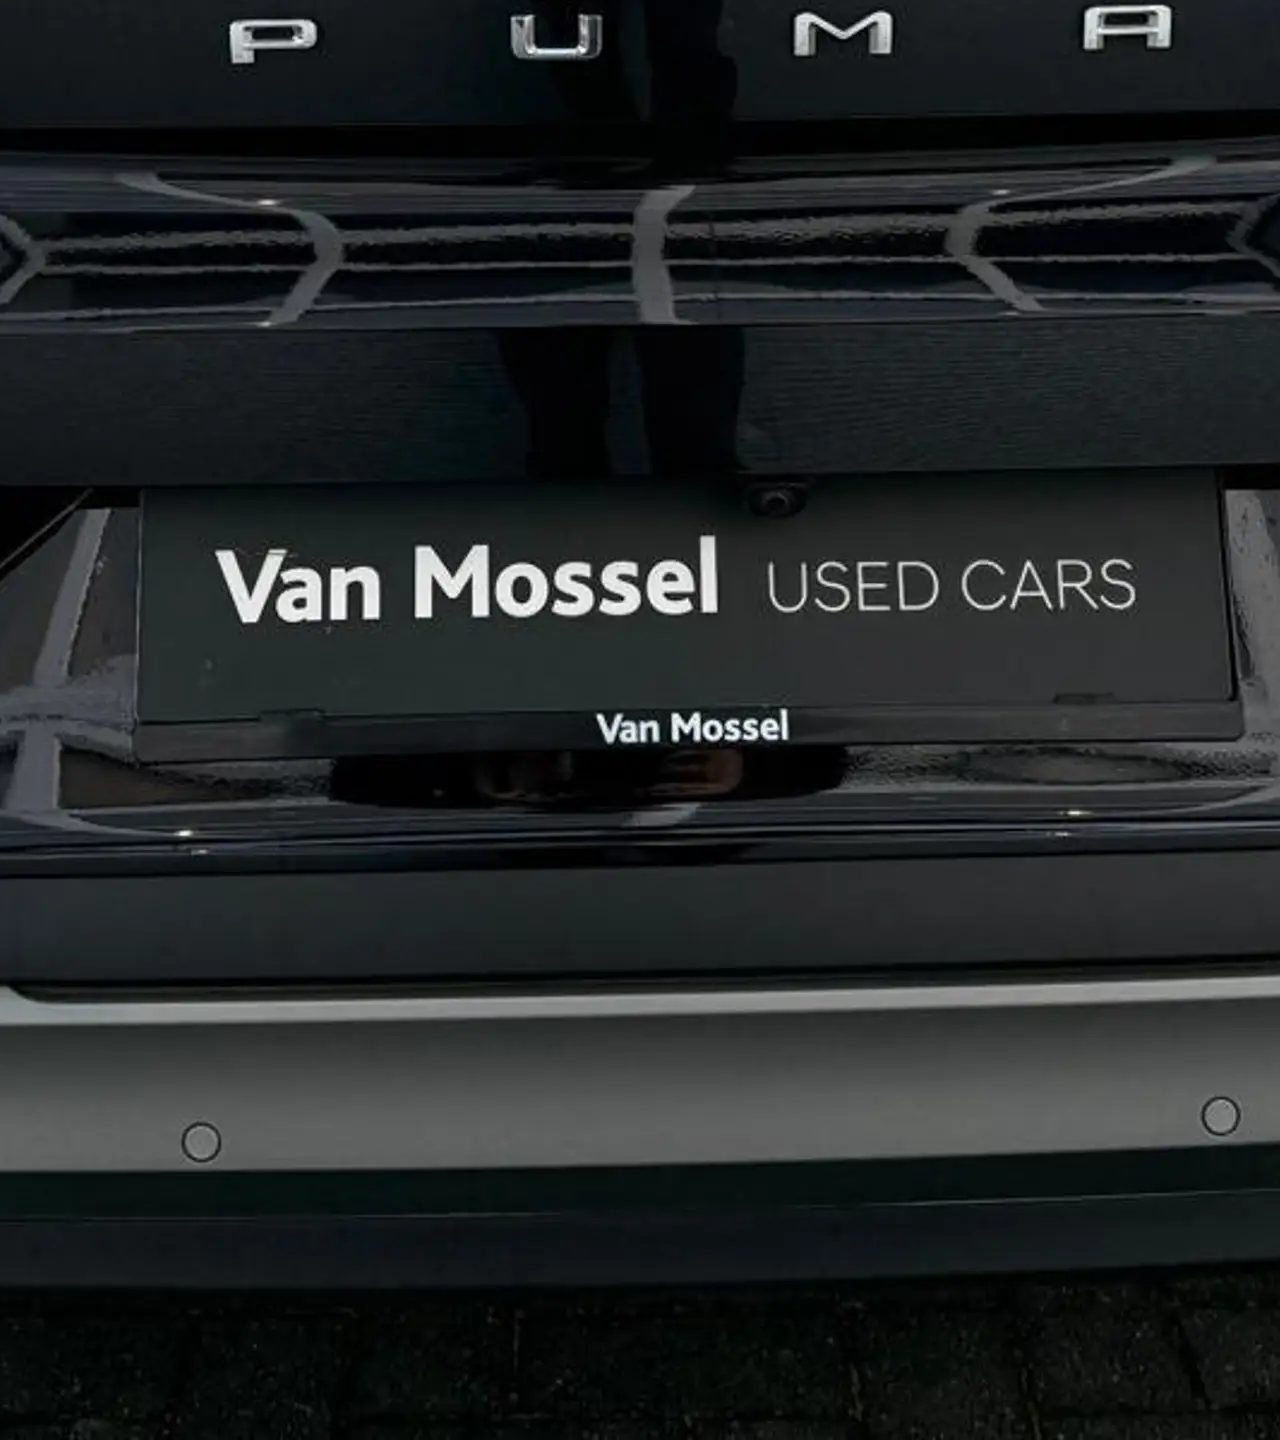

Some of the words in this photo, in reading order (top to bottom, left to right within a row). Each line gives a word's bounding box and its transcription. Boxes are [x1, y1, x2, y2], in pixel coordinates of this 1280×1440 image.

[229, 4, 1174, 65] PUMA
[214, 548, 380, 624] Van
[413, 536, 719, 620] Mossel
[766, 560, 939, 613] USED
[961, 558, 1136, 612] CARS
[595, 712, 661, 745] Van
[670, 707, 789, 744] Mossel
